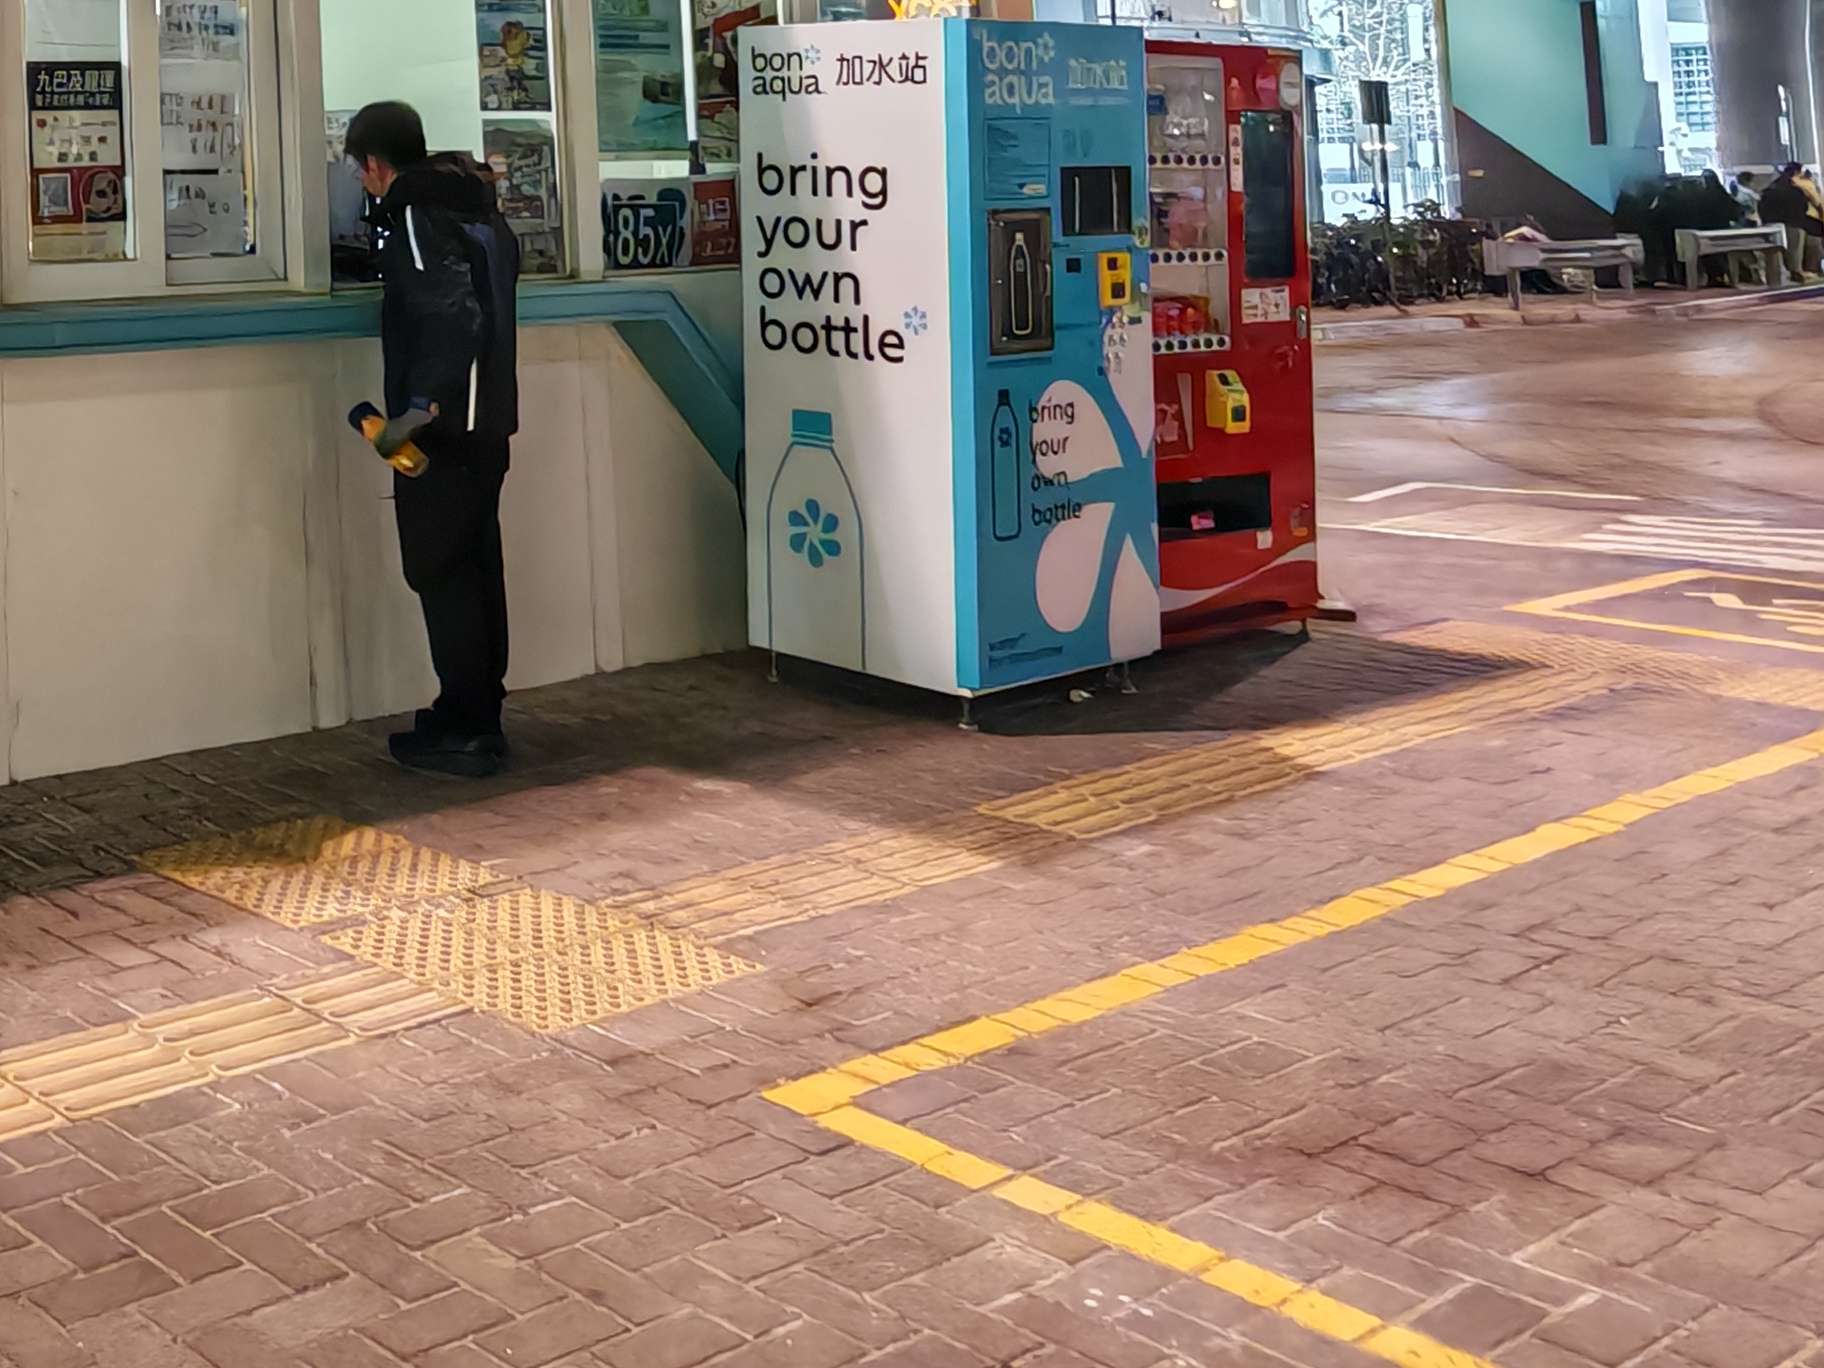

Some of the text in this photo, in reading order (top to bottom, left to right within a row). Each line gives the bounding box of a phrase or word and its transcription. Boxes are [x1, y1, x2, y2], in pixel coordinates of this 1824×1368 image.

[751, 45, 803, 72] bon
[981, 29, 1038, 70] bon
[835, 51, 928, 86] 加水站
[751, 74, 824, 102] aqua
[983, 73, 1056, 115] aqua
[756, 151, 887, 211] bring
[755, 215, 869, 258] your
[759, 267, 860, 305] own
[759, 305, 905, 363] bottle
[1029, 397, 1075, 425] bring
[1030, 436, 1070, 464] your
[1031, 470, 1068, 491] own
